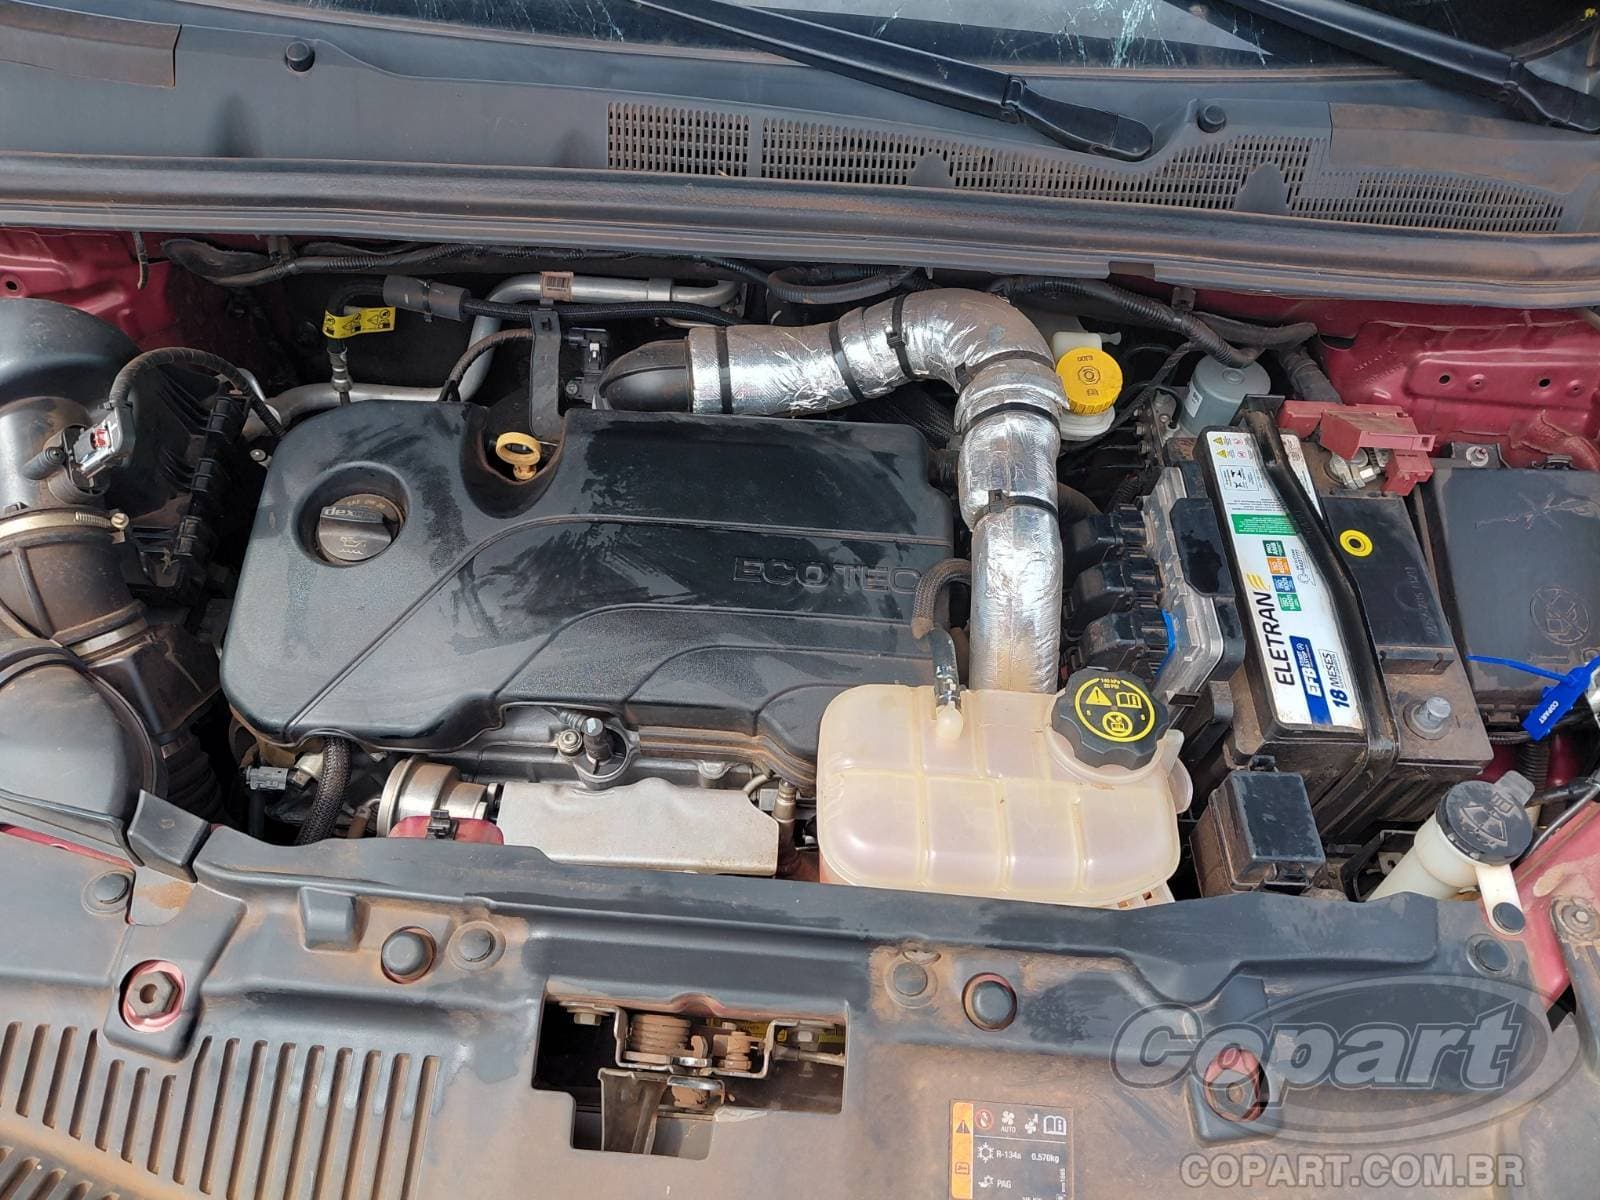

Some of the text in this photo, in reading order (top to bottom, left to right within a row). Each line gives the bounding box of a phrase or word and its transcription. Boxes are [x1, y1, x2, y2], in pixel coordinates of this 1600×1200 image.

[733, 557, 921, 594] ECOTEC
[1255, 592, 1295, 686] ELETRAN
[1301, 667, 1322, 697] EFB
[1322, 652, 1350, 708] 18 MESES
[1538, 701, 1559, 724] COPART
[996, 1150, 1022, 1160] R-134a
[997, 1180, 1012, 1189] PAG
